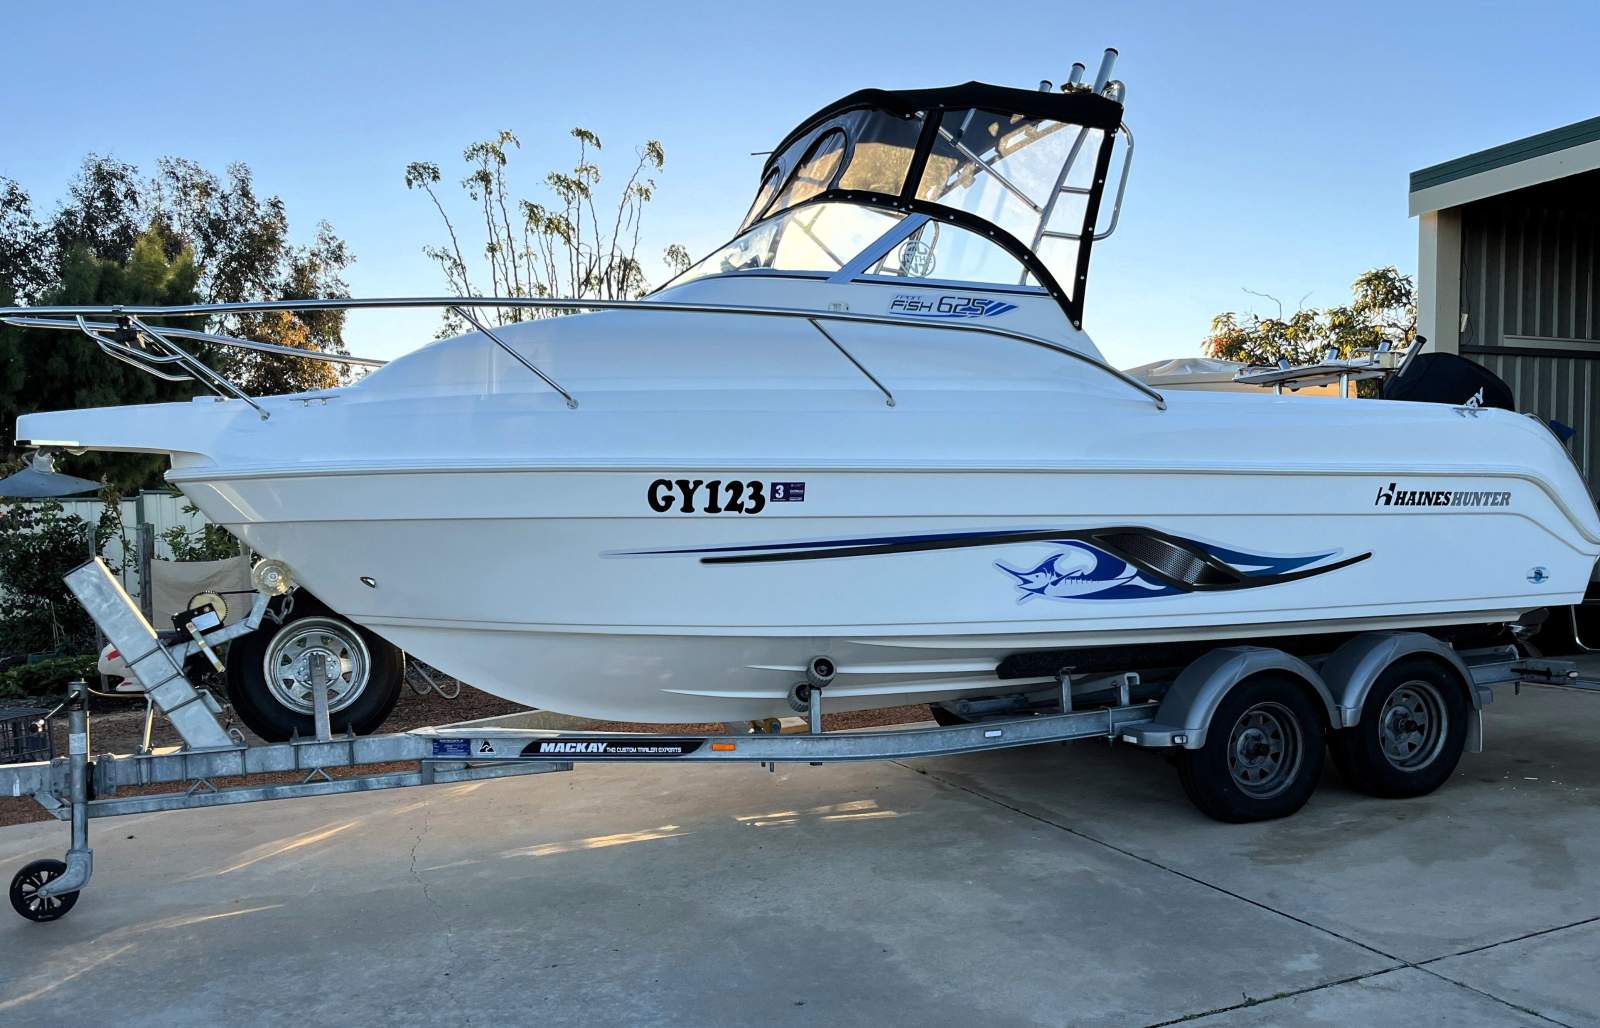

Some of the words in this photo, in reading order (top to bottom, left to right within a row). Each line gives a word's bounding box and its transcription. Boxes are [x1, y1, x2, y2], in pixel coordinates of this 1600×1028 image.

[937, 296, 987, 315] 625
[648, 479, 766, 514] GY123
[775, 485, 784, 498] 3
[540, 743, 607, 752] MACKAY
